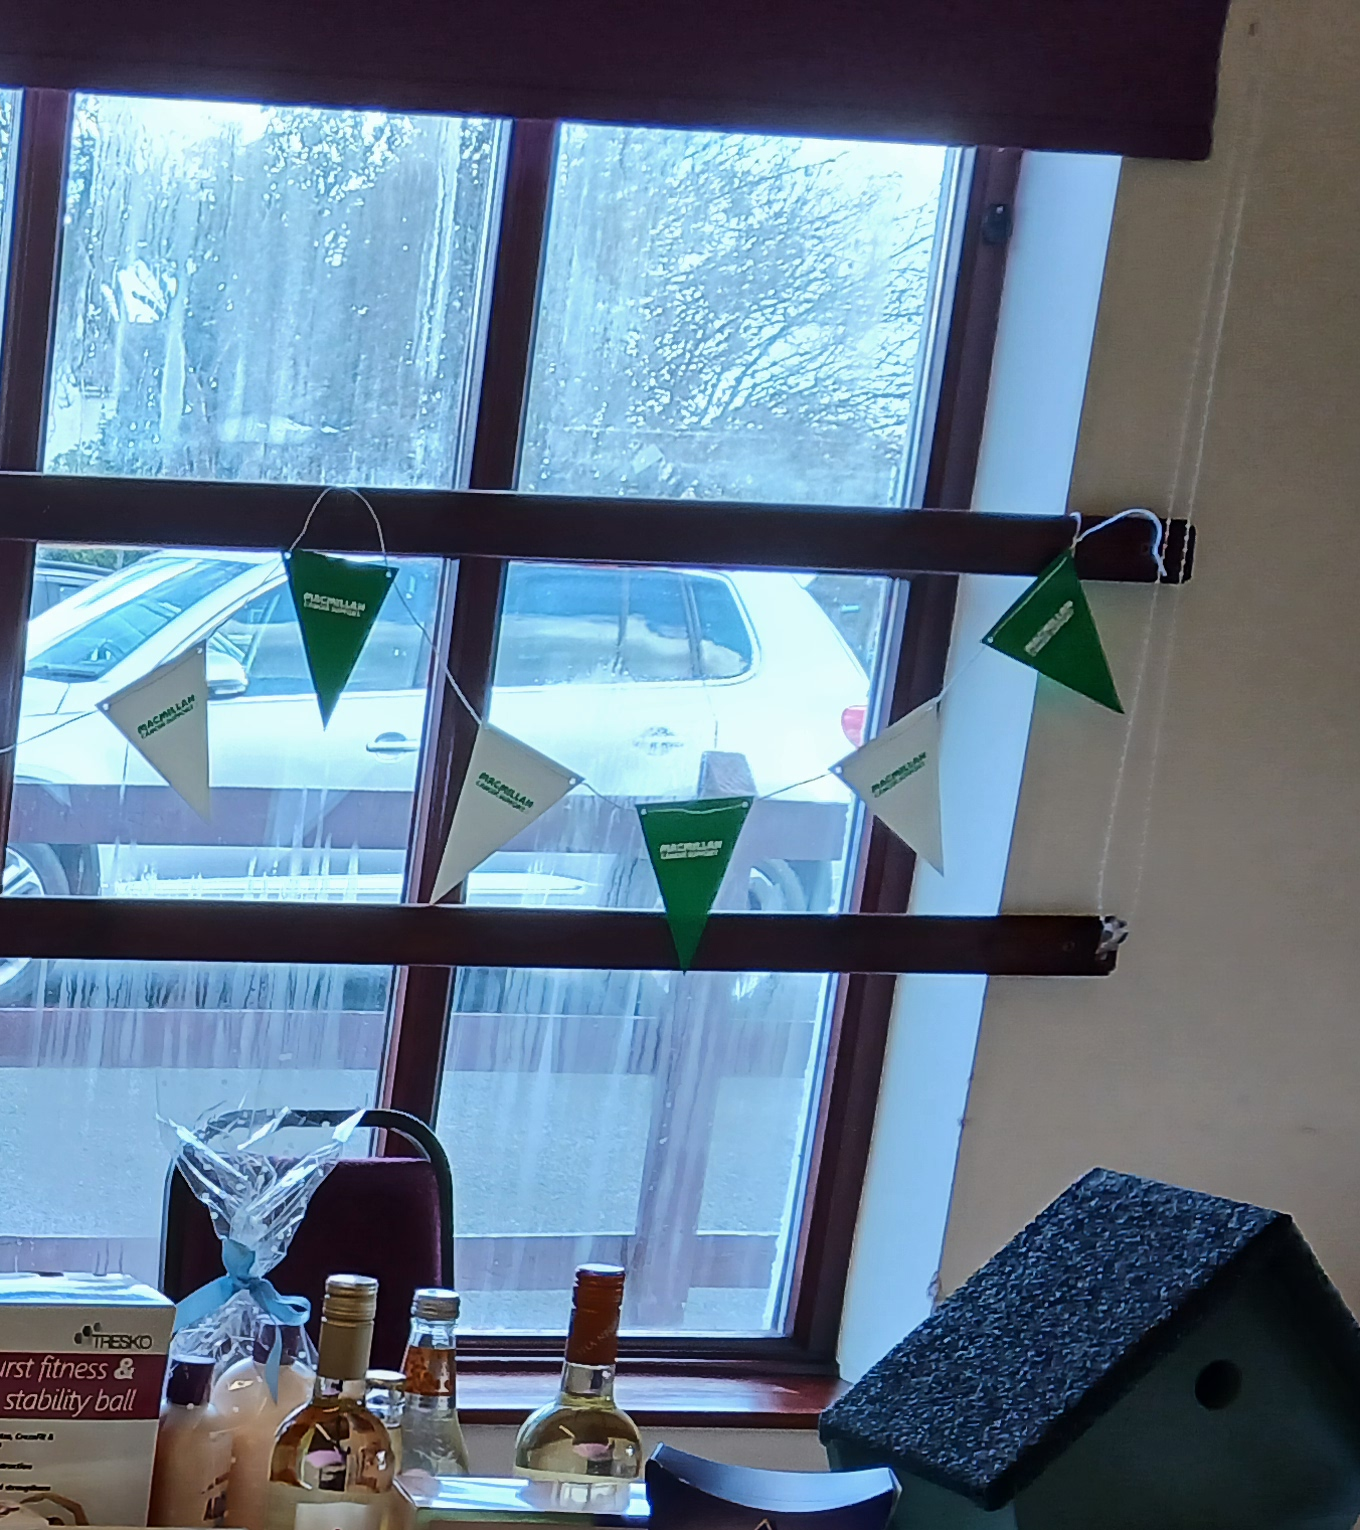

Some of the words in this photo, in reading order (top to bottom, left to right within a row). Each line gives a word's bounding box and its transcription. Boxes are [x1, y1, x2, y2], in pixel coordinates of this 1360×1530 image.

[303, 592, 365, 611] MACMILLAN
[137, 694, 195, 735] MACMILLAN
[478, 772, 534, 809] MACMILLAN
[92, 1333, 153, 1350] TRESKO
[37, 1355, 109, 1383] fitness
[113, 1357, 135, 1381] &
[3, 1388, 93, 1418] stability
[95, 1389, 138, 1412] ball
